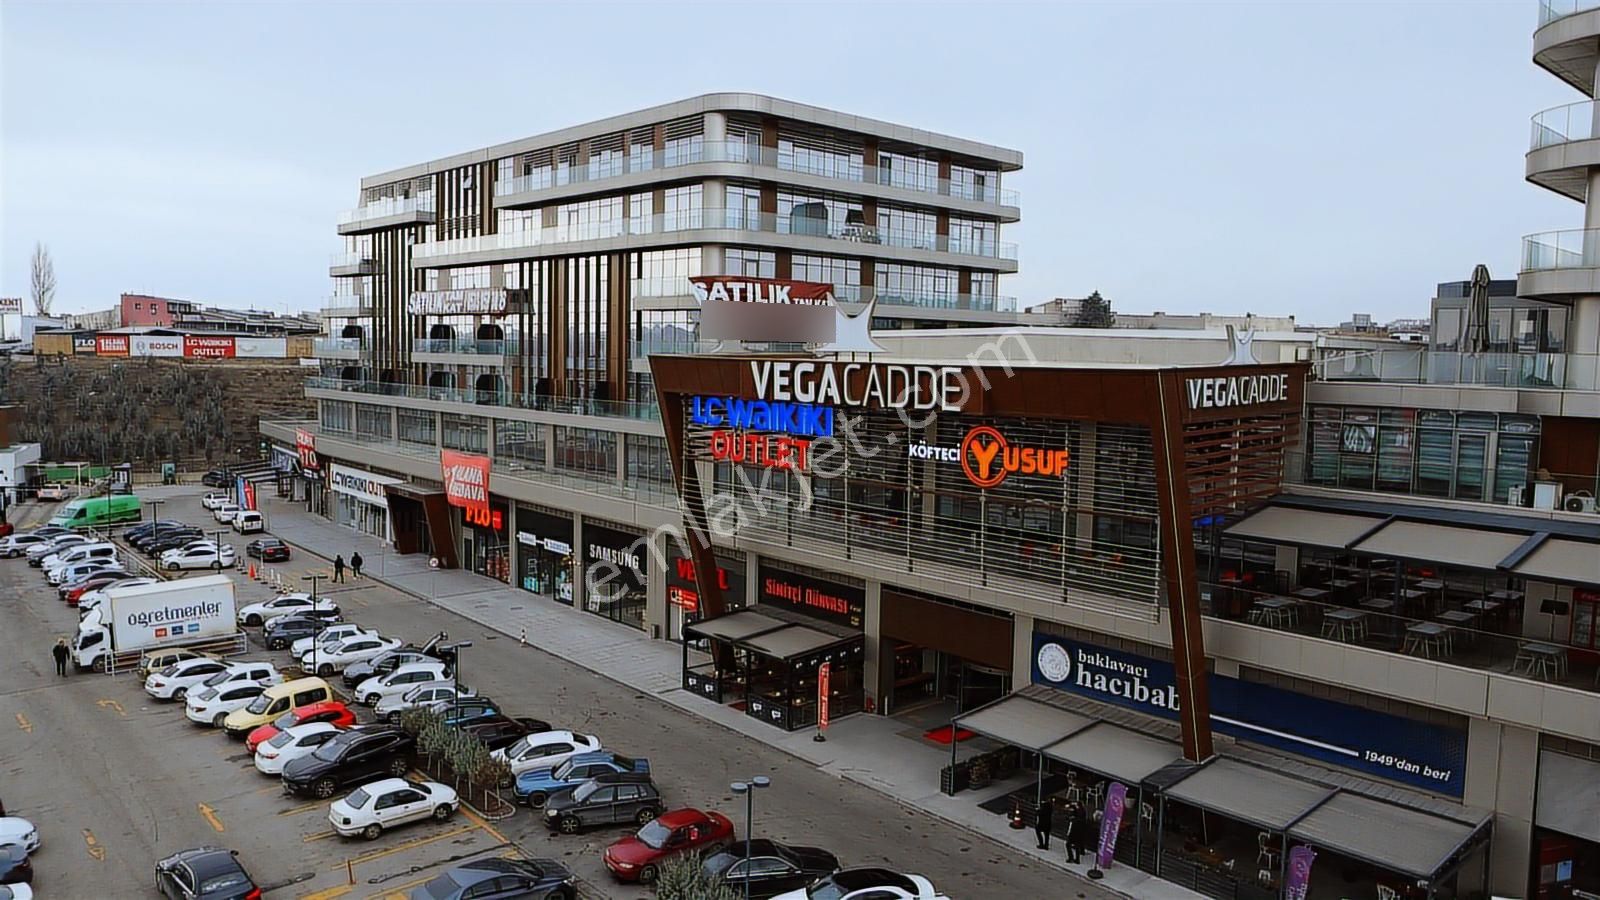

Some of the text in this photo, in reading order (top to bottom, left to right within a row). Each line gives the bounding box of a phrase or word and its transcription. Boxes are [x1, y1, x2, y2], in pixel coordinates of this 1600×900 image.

[192, 348, 225, 356] OUTLET
[751, 361, 962, 412] VEGACADDE
[1187, 374, 1289, 410] VEGACADDE
[692, 396, 723, 425] LC
[711, 429, 811, 471] OUTLET
[909, 432, 1068, 482] KÖFTECİ YUSUF
[589, 543, 640, 570] SAMSUNG
[1078, 649, 1148, 678] baklavacı
[1365, 750, 1451, 782] 1949'dan beri
